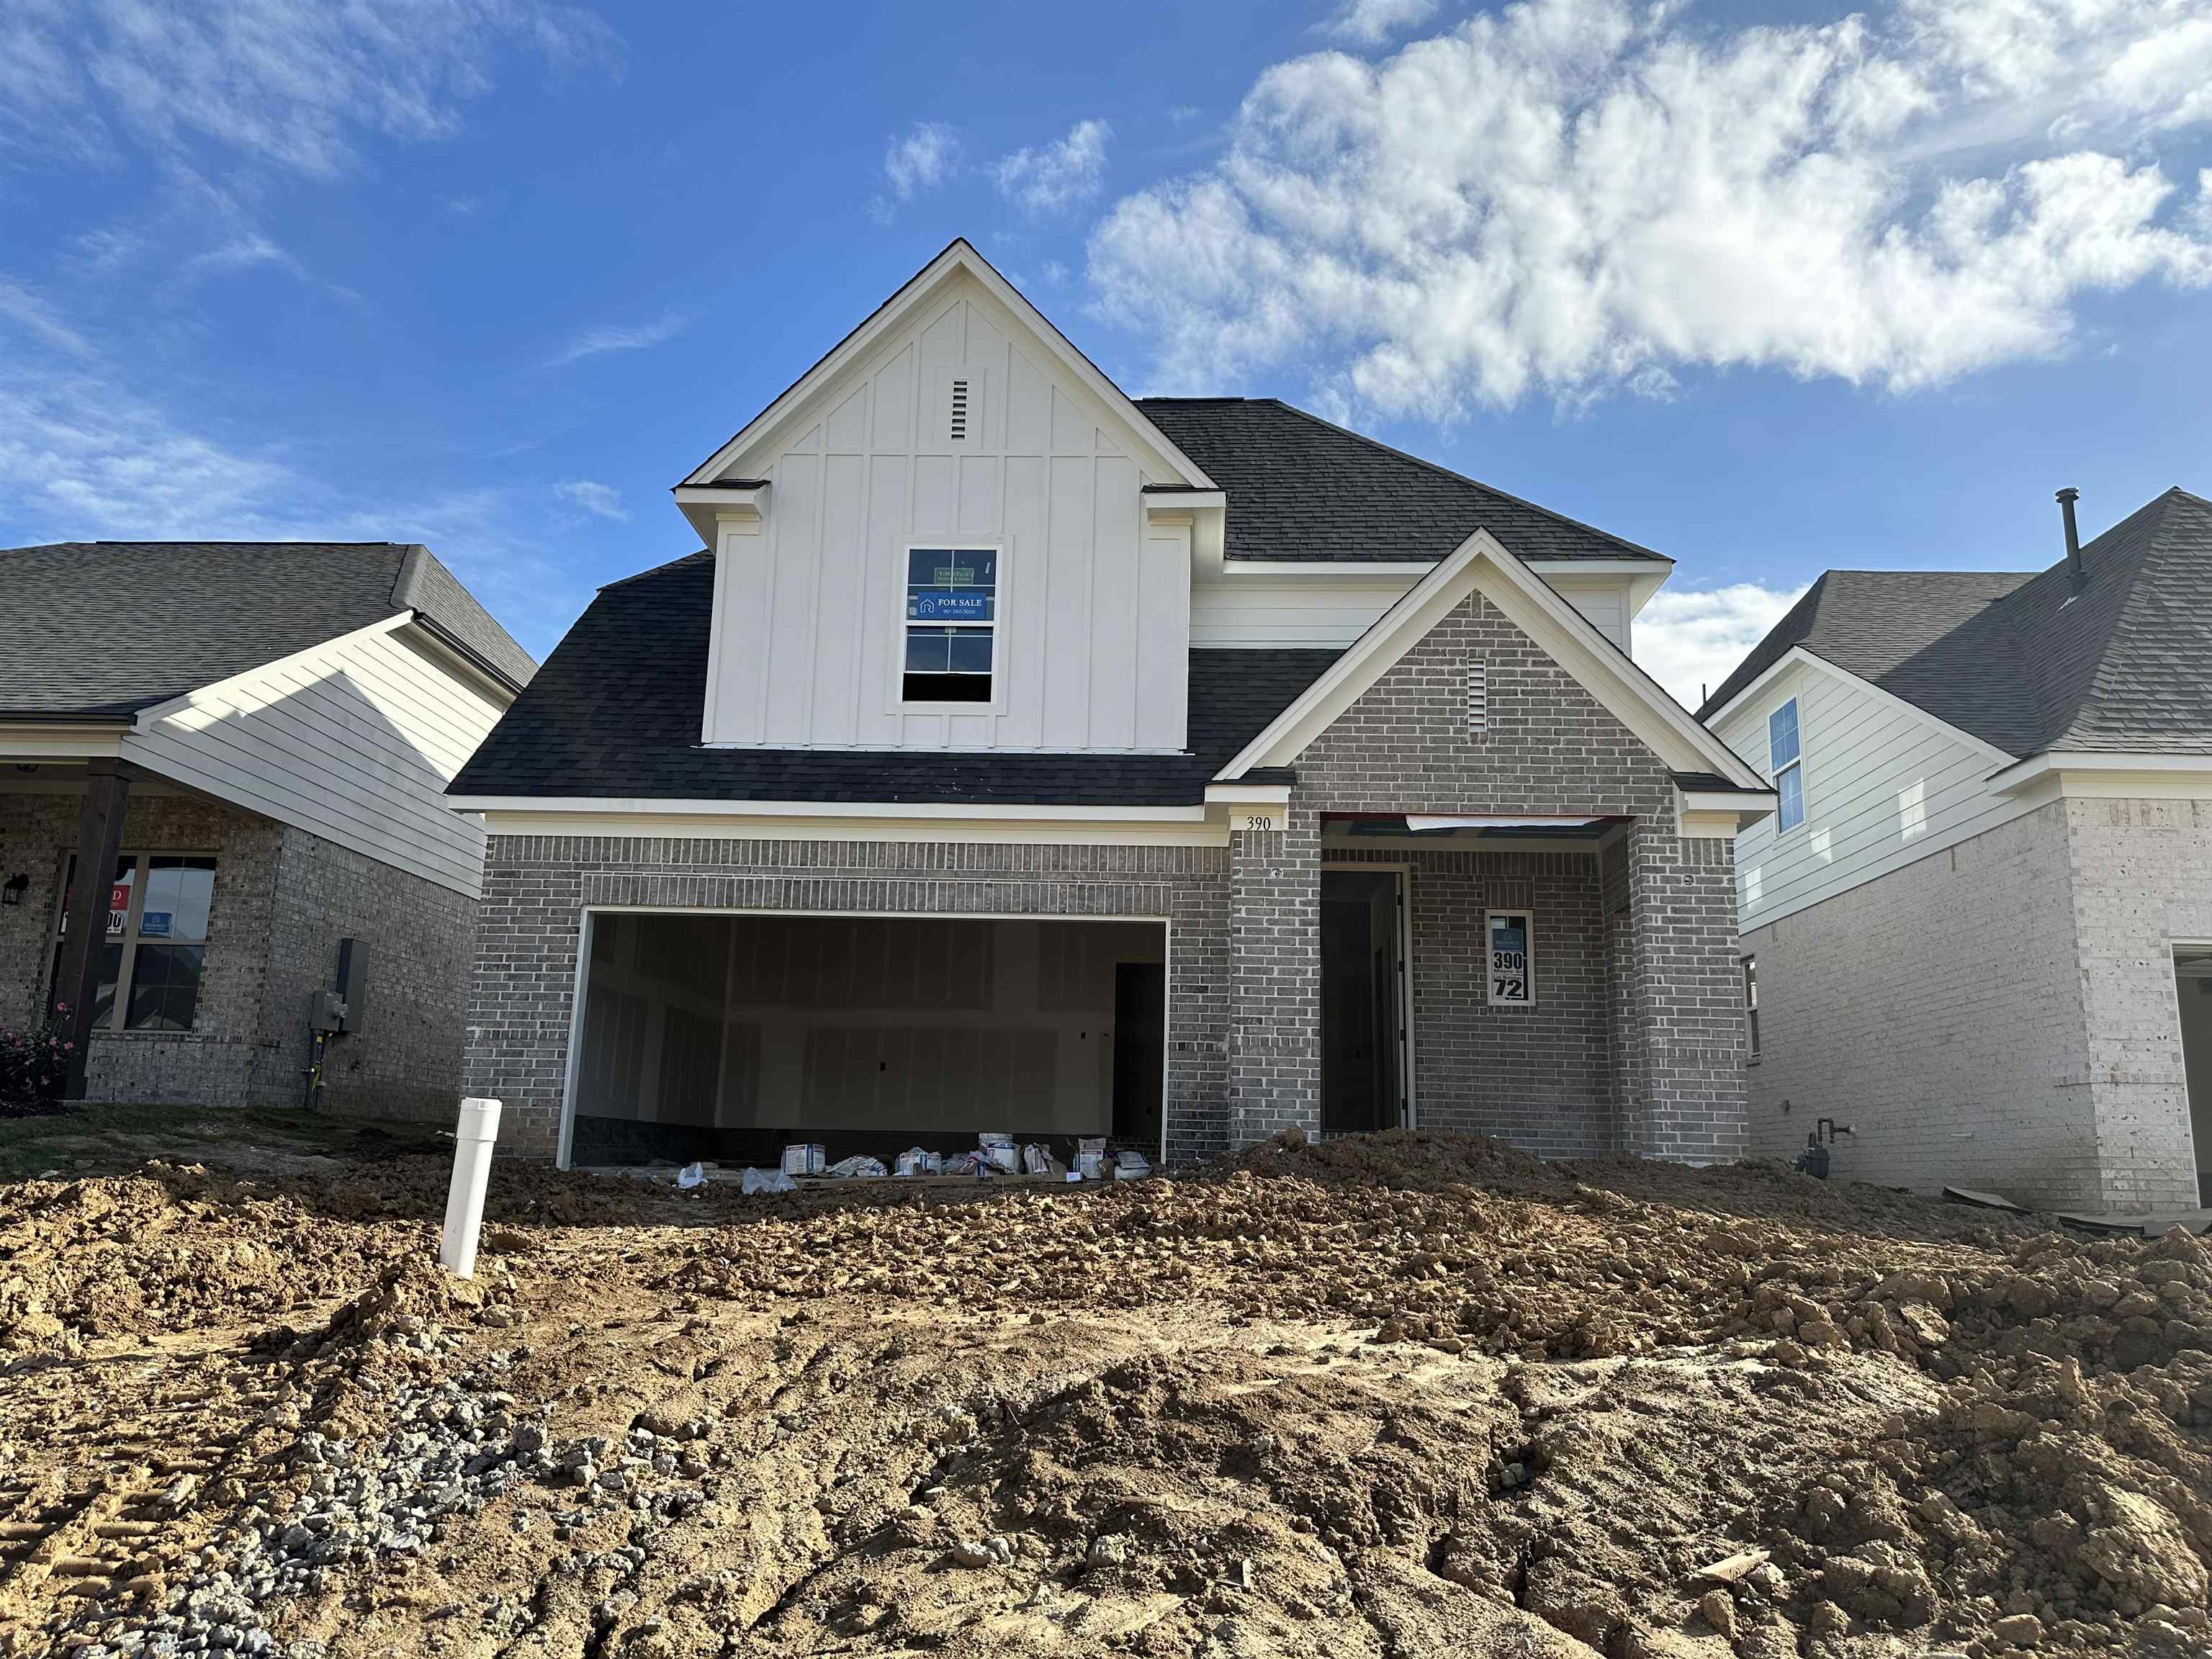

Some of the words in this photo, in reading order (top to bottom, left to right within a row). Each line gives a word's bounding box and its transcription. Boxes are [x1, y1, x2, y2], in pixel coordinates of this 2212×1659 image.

[1246, 817, 1271, 831] 390
[1493, 952, 1522, 969] 390
[1493, 979, 1522, 997] 72
